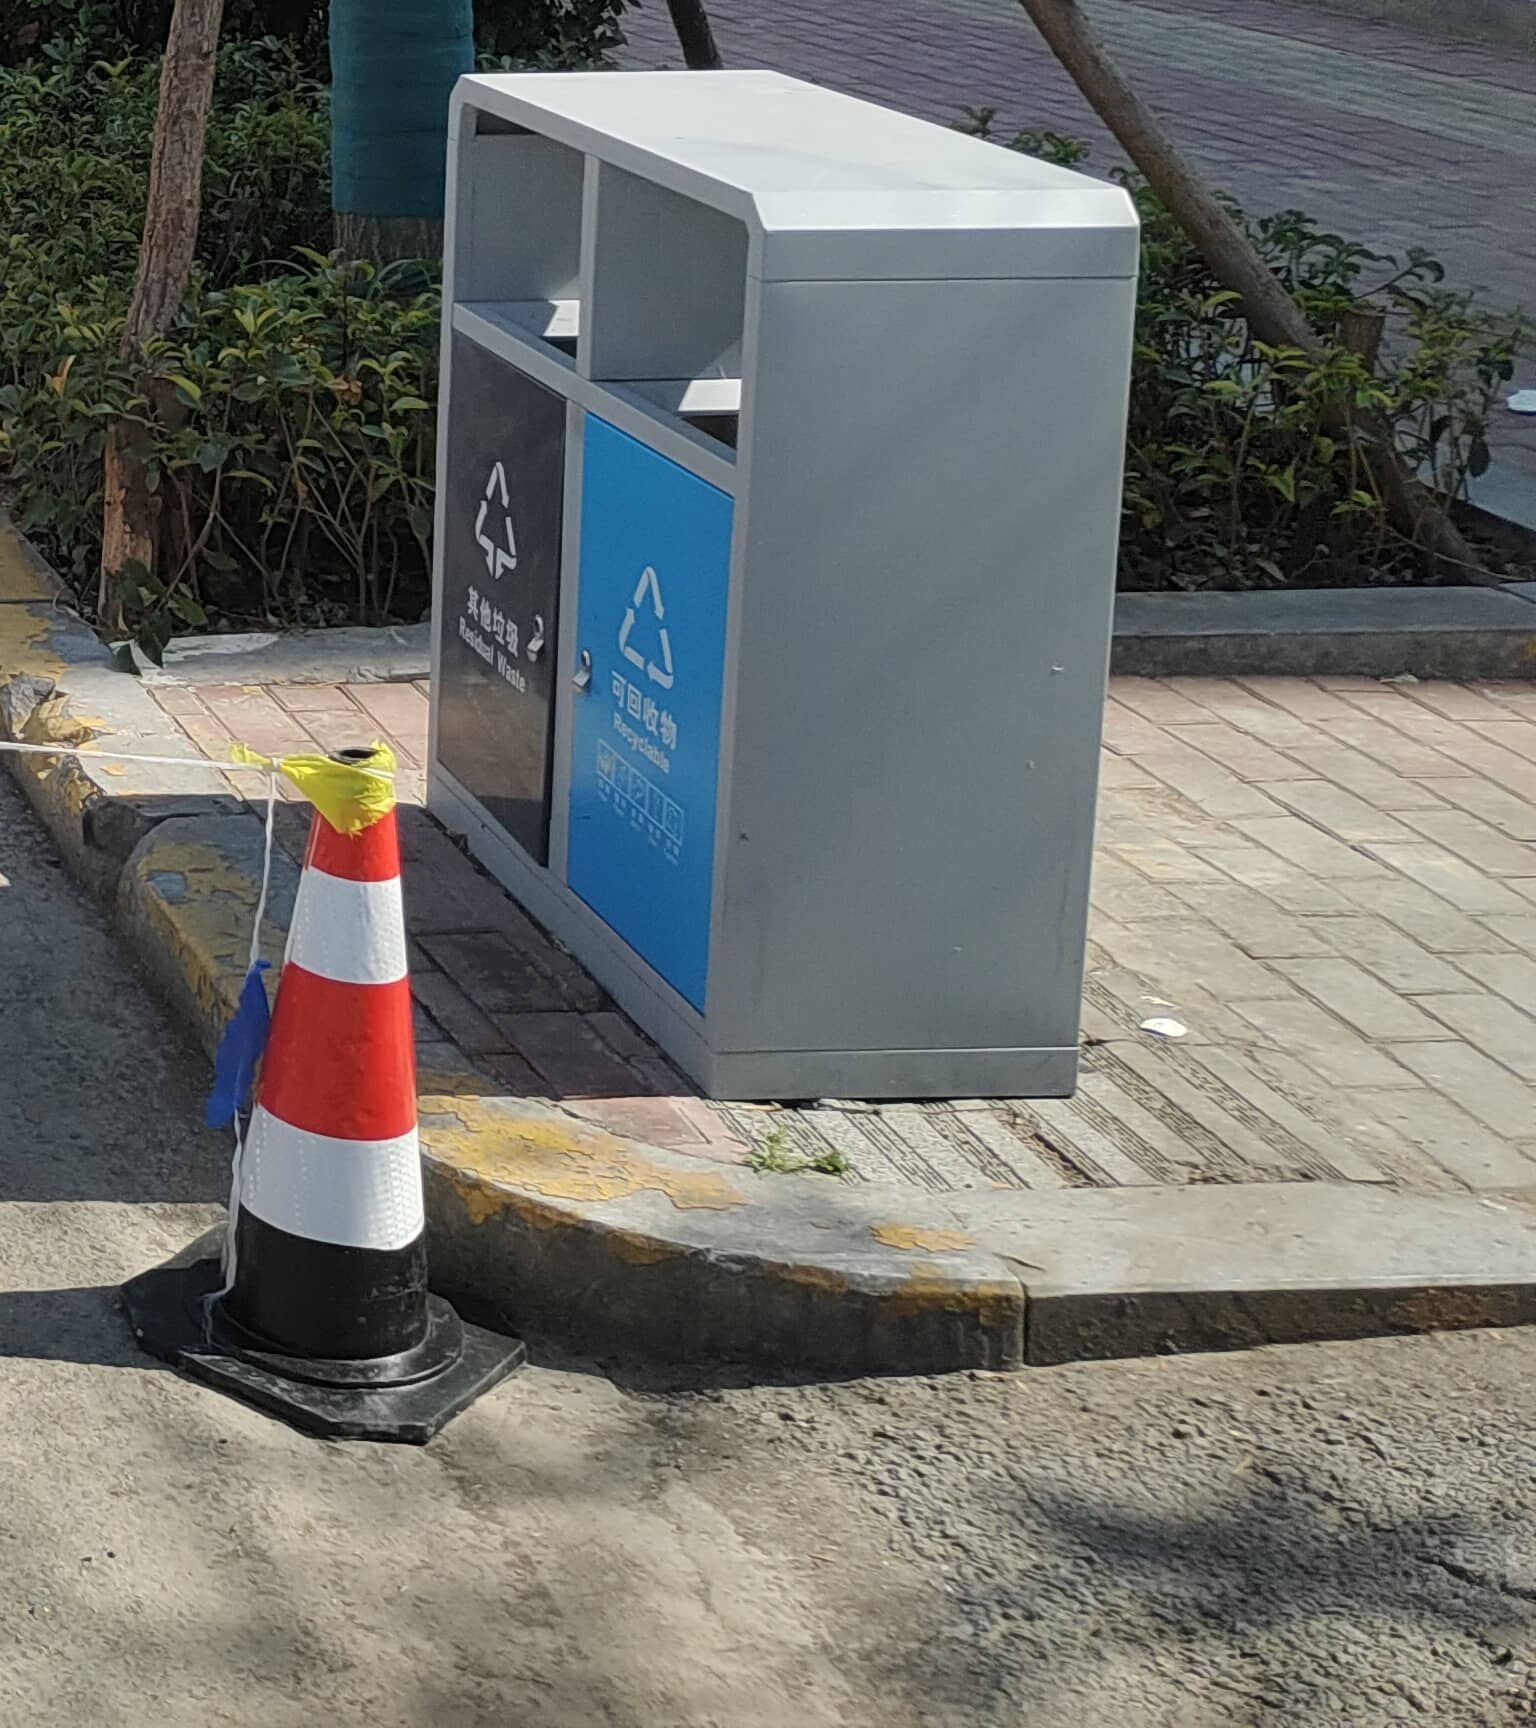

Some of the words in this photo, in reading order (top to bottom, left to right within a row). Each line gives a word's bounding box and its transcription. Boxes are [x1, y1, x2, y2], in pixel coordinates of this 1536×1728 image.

[459, 615, 494, 666] Residual
[497, 650, 526, 694] Waste
[466, 584, 519, 658] 其他垃圾
[611, 669, 678, 751] 可回收物
[612, 710, 671, 775] Recyclable
